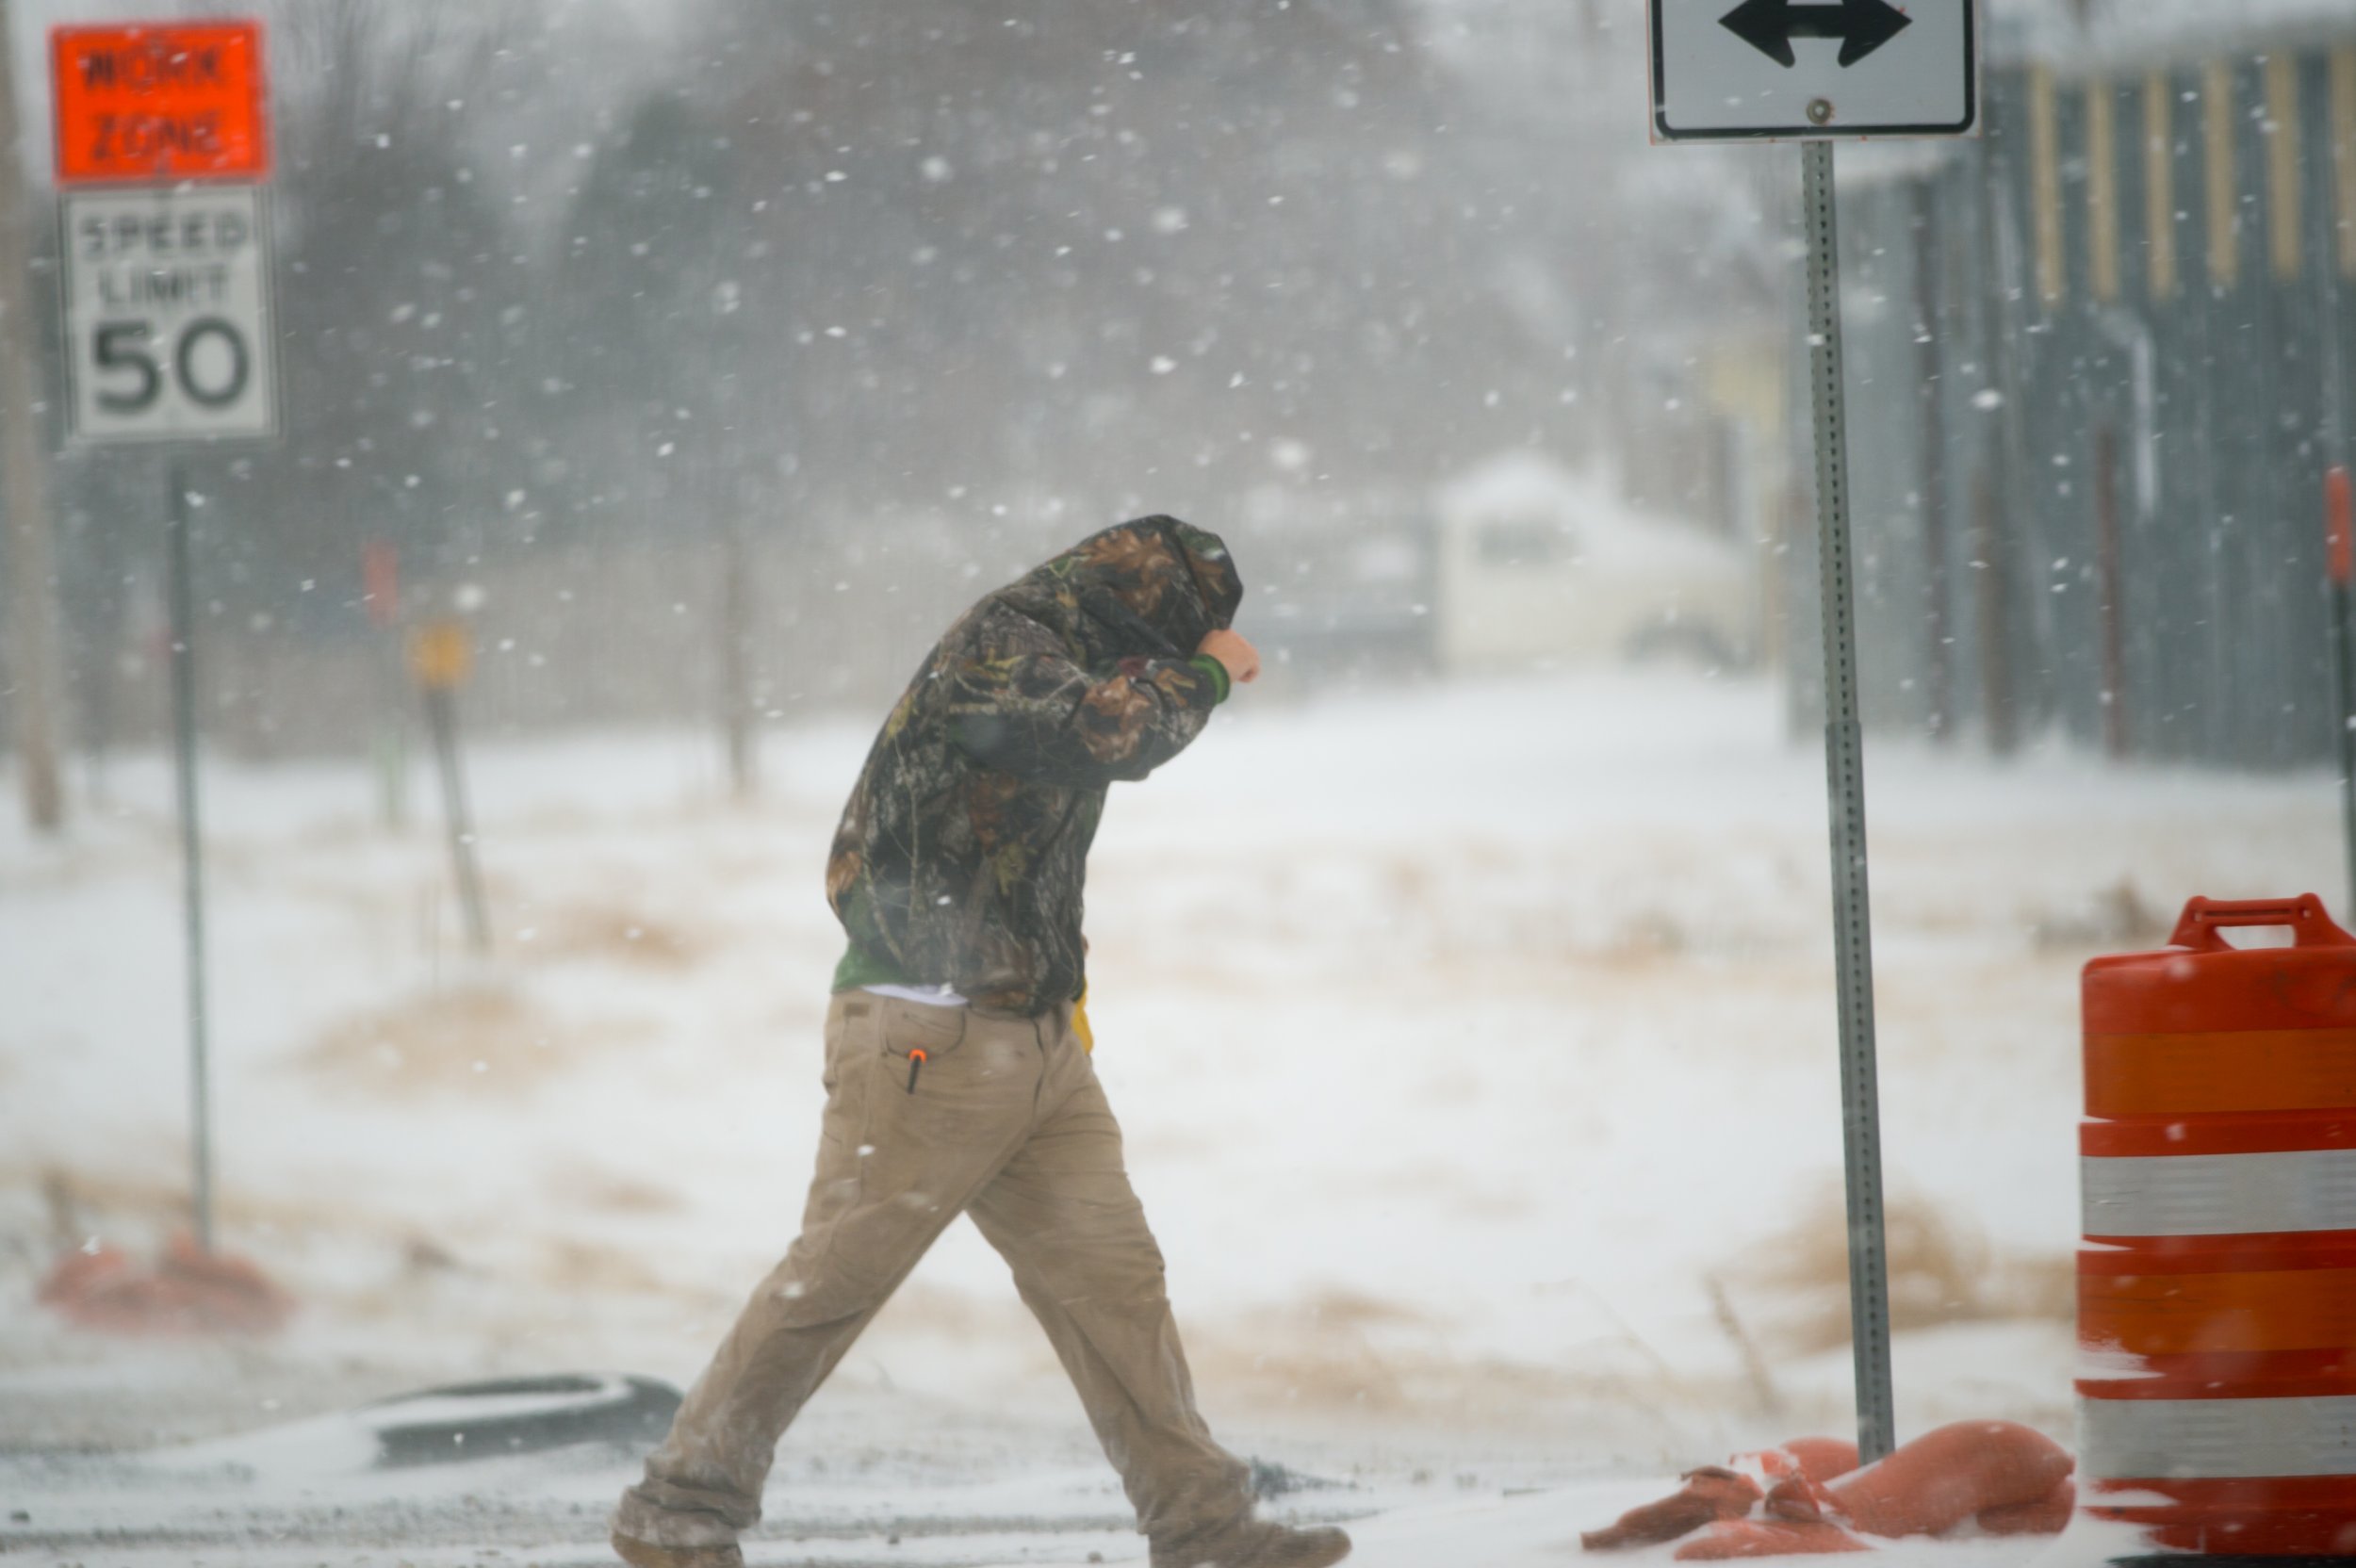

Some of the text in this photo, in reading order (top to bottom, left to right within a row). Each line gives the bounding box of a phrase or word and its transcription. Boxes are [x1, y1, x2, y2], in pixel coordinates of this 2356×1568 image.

[79, 47, 223, 90] WORK
[90, 112, 223, 160] ZONE
[80, 212, 249, 257] SPEED
[98, 265, 231, 307] LIMIT
[92, 316, 250, 415] 50
